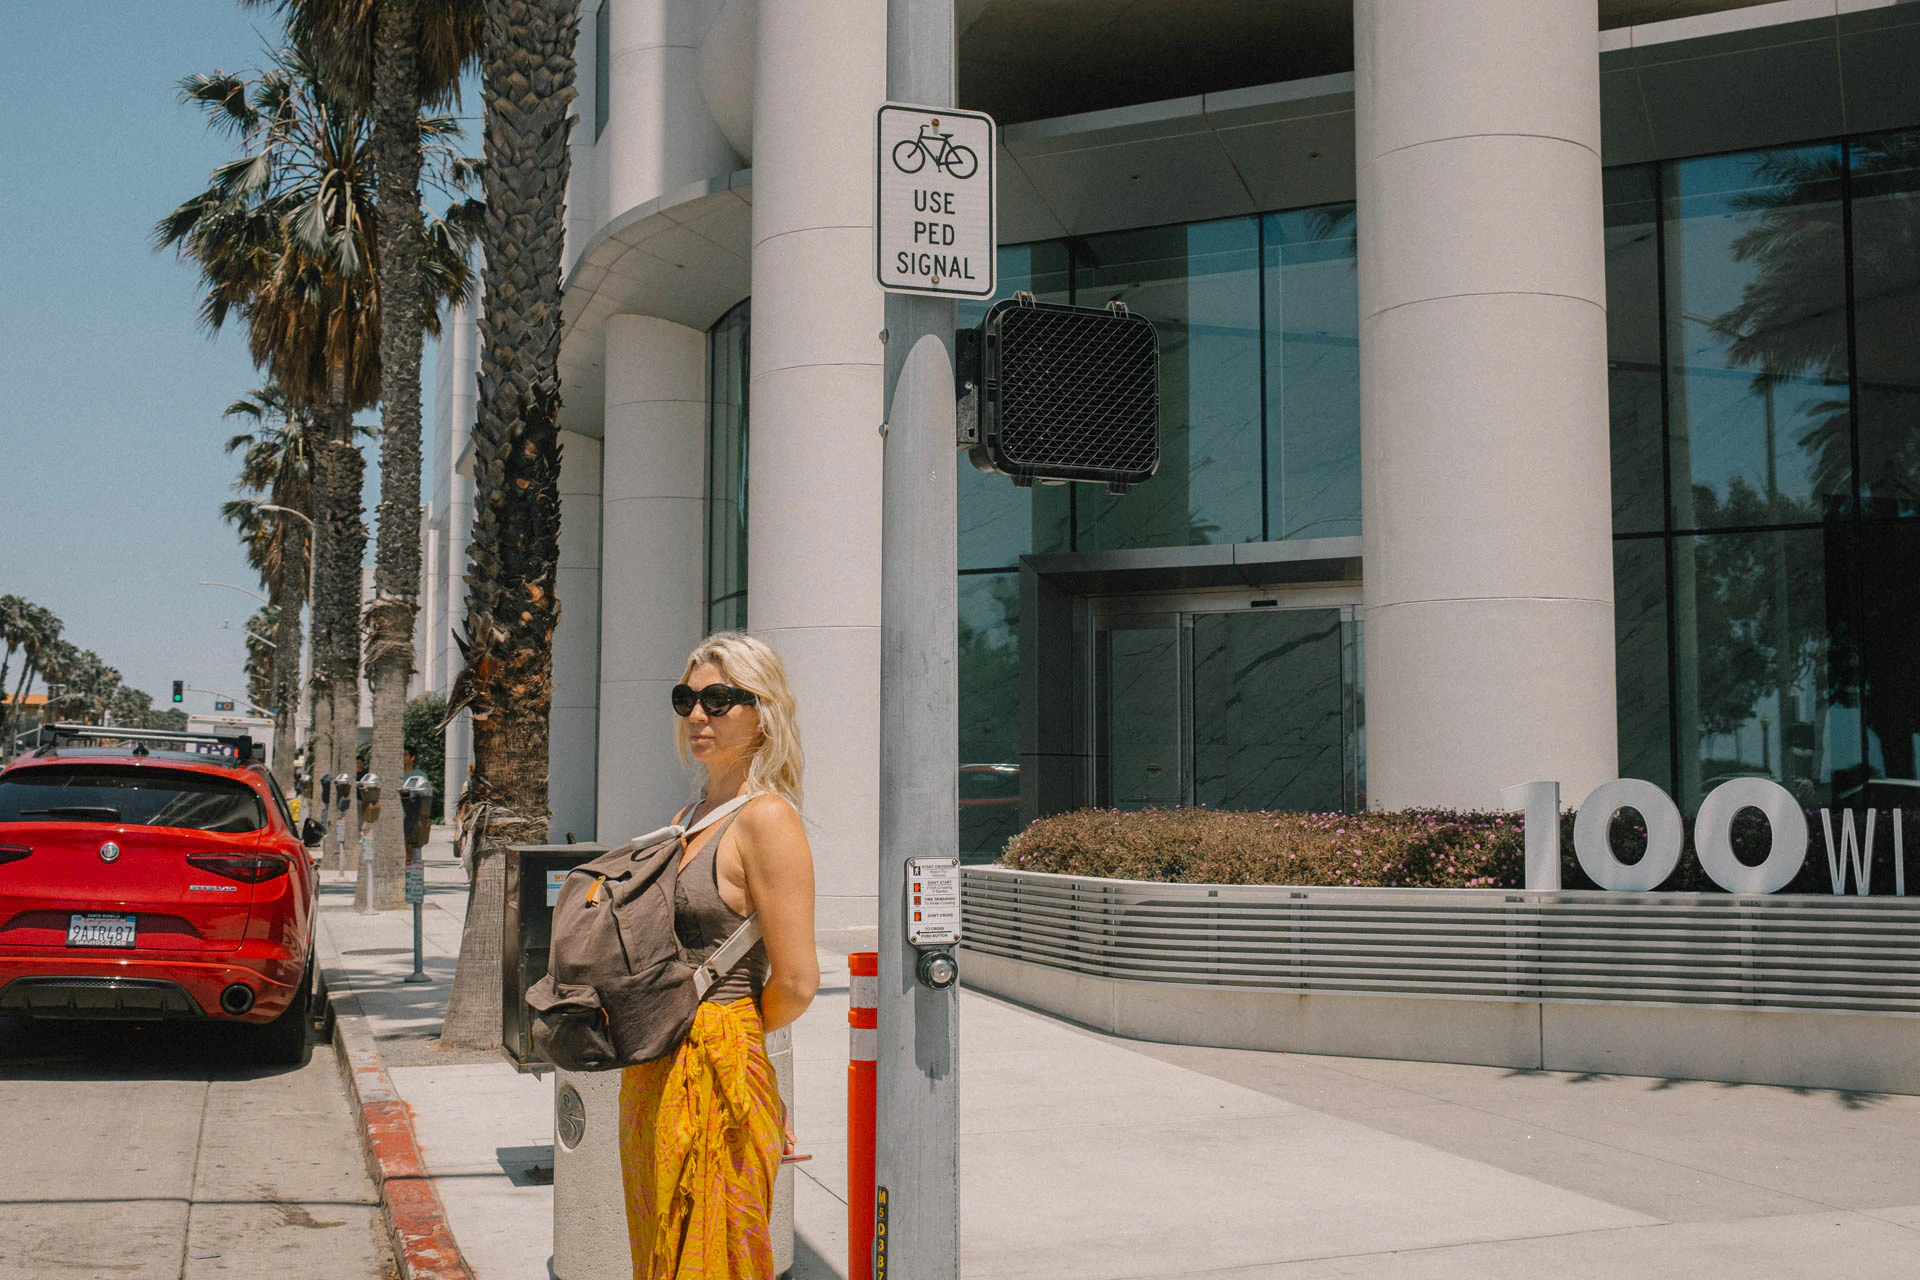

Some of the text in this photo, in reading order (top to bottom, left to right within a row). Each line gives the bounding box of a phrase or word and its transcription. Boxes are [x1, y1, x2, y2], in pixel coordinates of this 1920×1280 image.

[914, 189, 955, 215] USE
[914, 221, 955, 246] PED
[896, 251, 975, 280] SIGNAL
[1501, 777, 1905, 897] 100 WI
[189, 884, 238, 892] STELVIO
